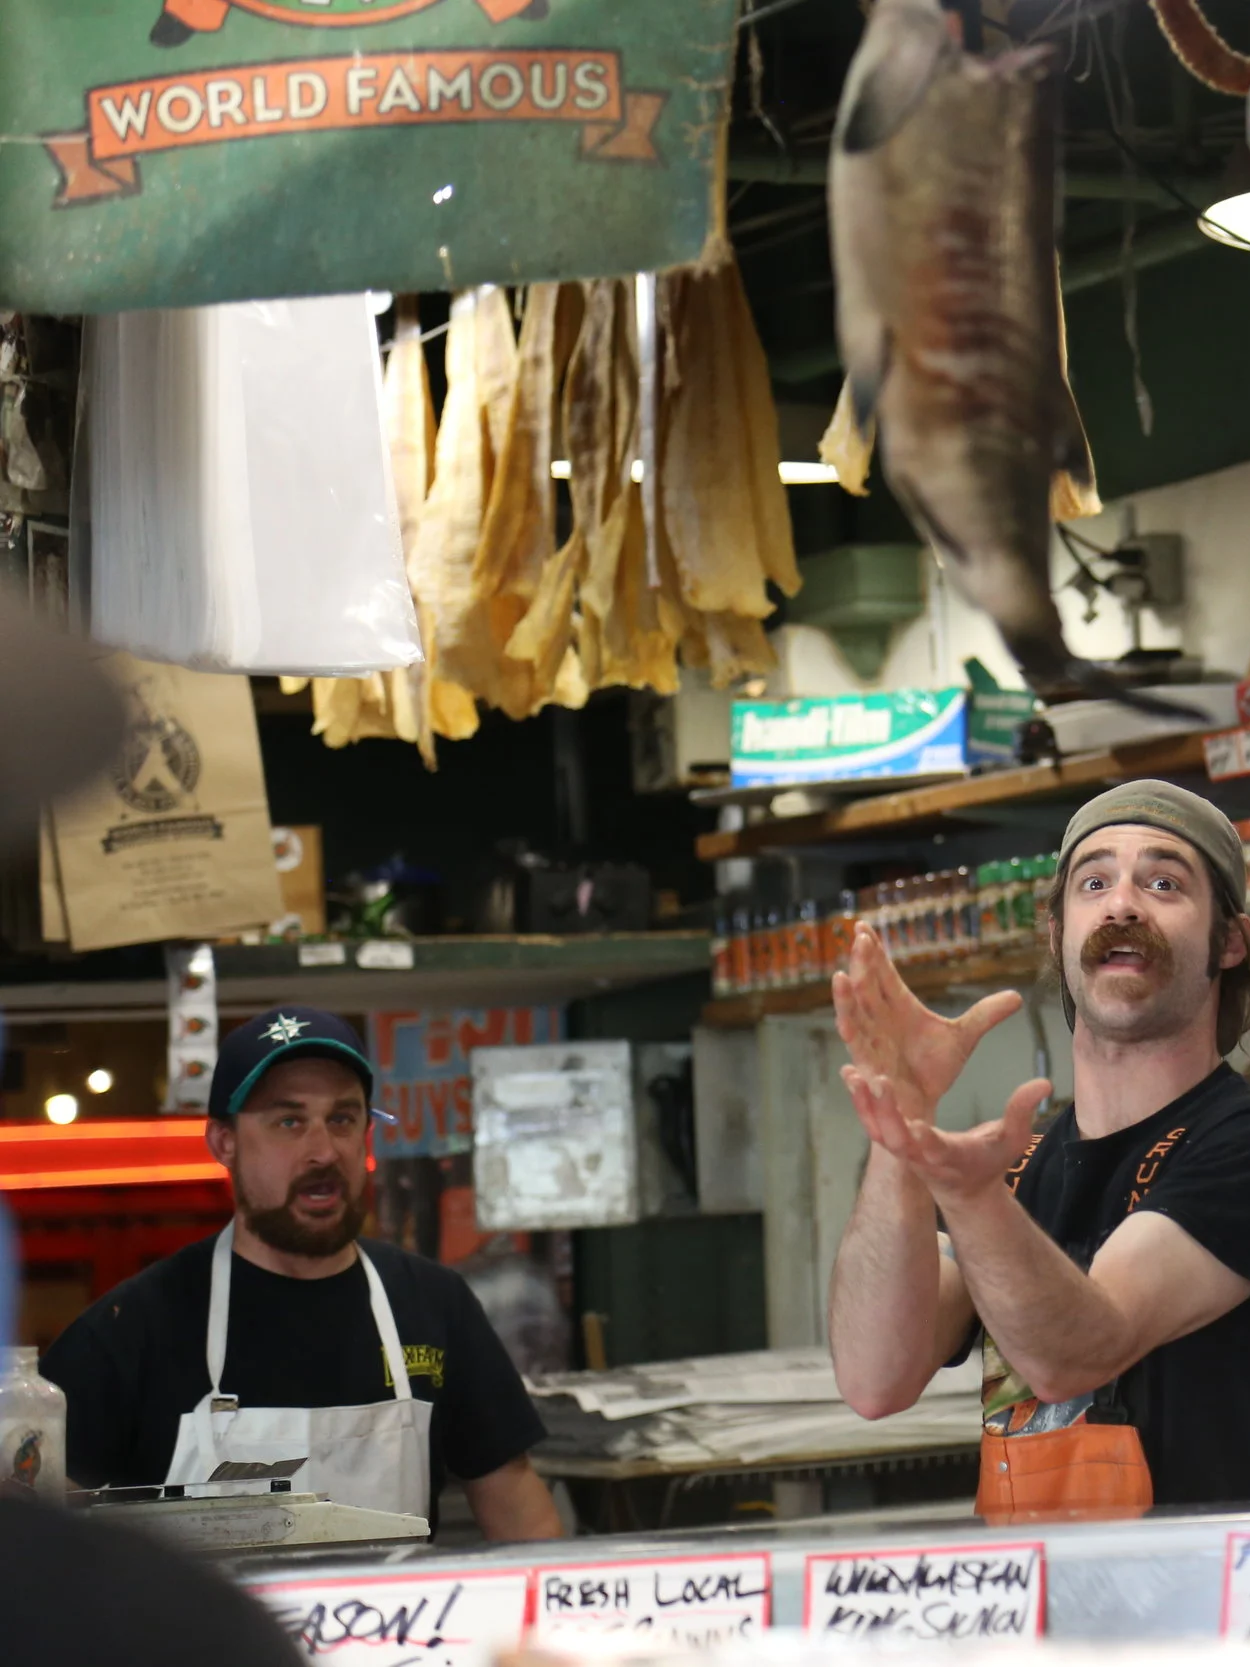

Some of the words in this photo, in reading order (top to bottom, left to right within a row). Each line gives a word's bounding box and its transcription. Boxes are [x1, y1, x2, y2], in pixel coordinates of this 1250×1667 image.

[100, 72, 329, 142] WORLD
[346, 61, 610, 117] FAMOUS
[545, 1577, 630, 1610] FRESH
[654, 1571, 769, 1607] LOCAL
